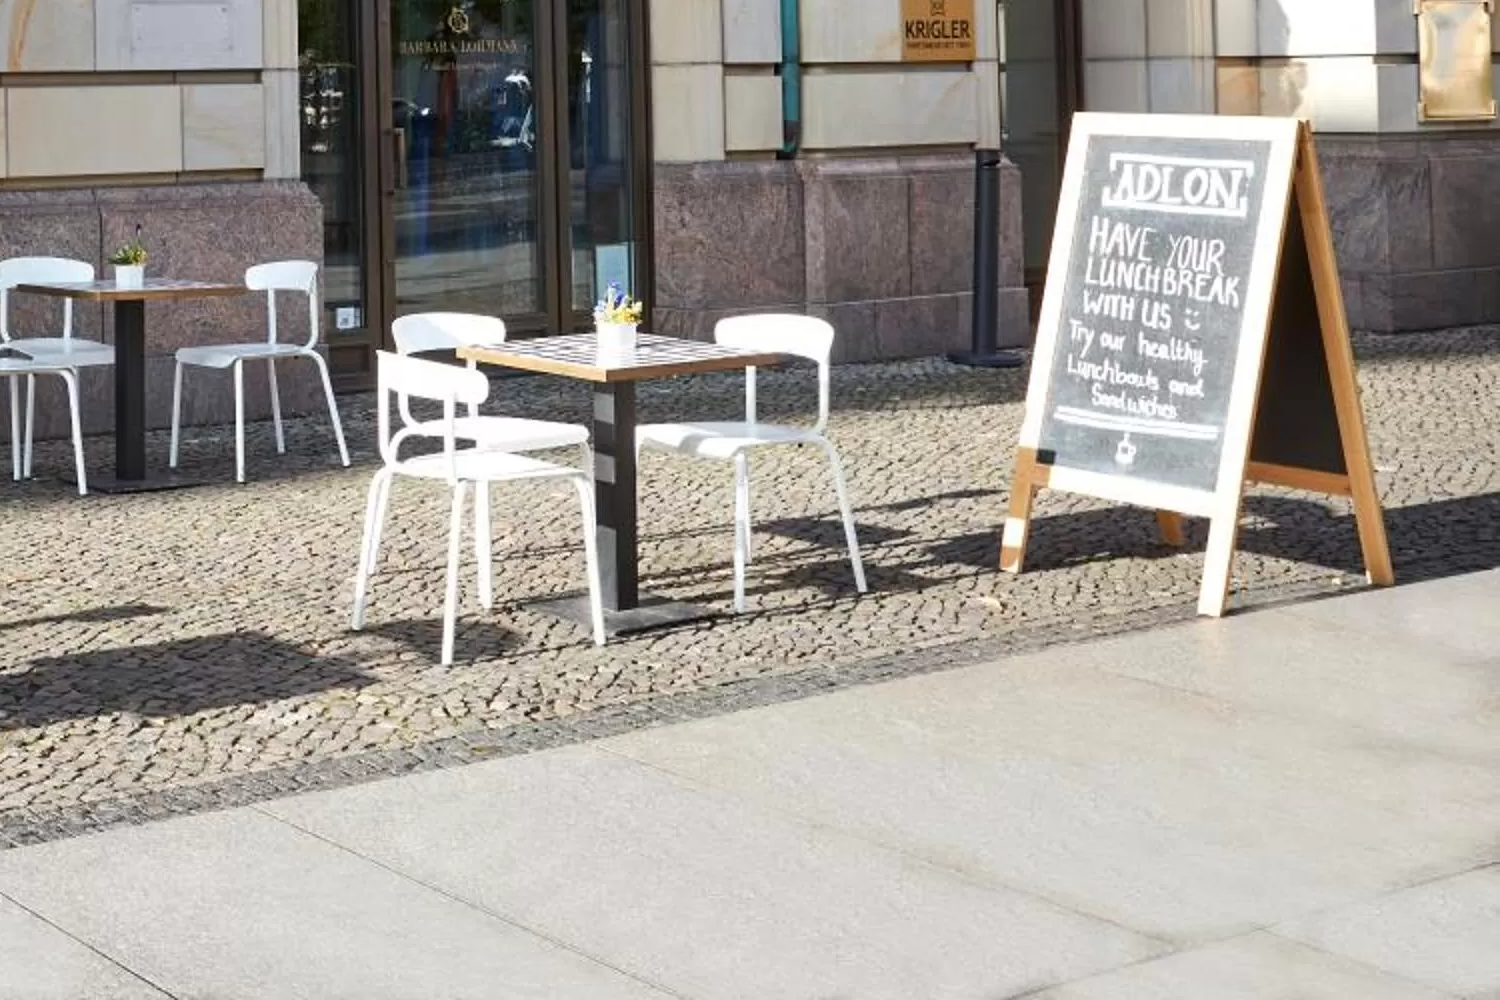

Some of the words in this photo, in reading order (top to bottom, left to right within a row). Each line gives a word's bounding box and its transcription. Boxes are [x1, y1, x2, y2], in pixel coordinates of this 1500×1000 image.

[905, 19, 971, 39] KRIGLER
[1111, 163, 1247, 208] ADLON
[1089, 215, 1156, 261] HAVE
[1167, 234, 1225, 276] YOUR
[1083, 289, 1135, 321] WITH
[1141, 301, 1172, 330] US
[1069, 319, 1095, 358] Try
[1100, 331, 1126, 352] our
[1138, 331, 1208, 376] healthy
[1169, 378, 1205, 398] and
